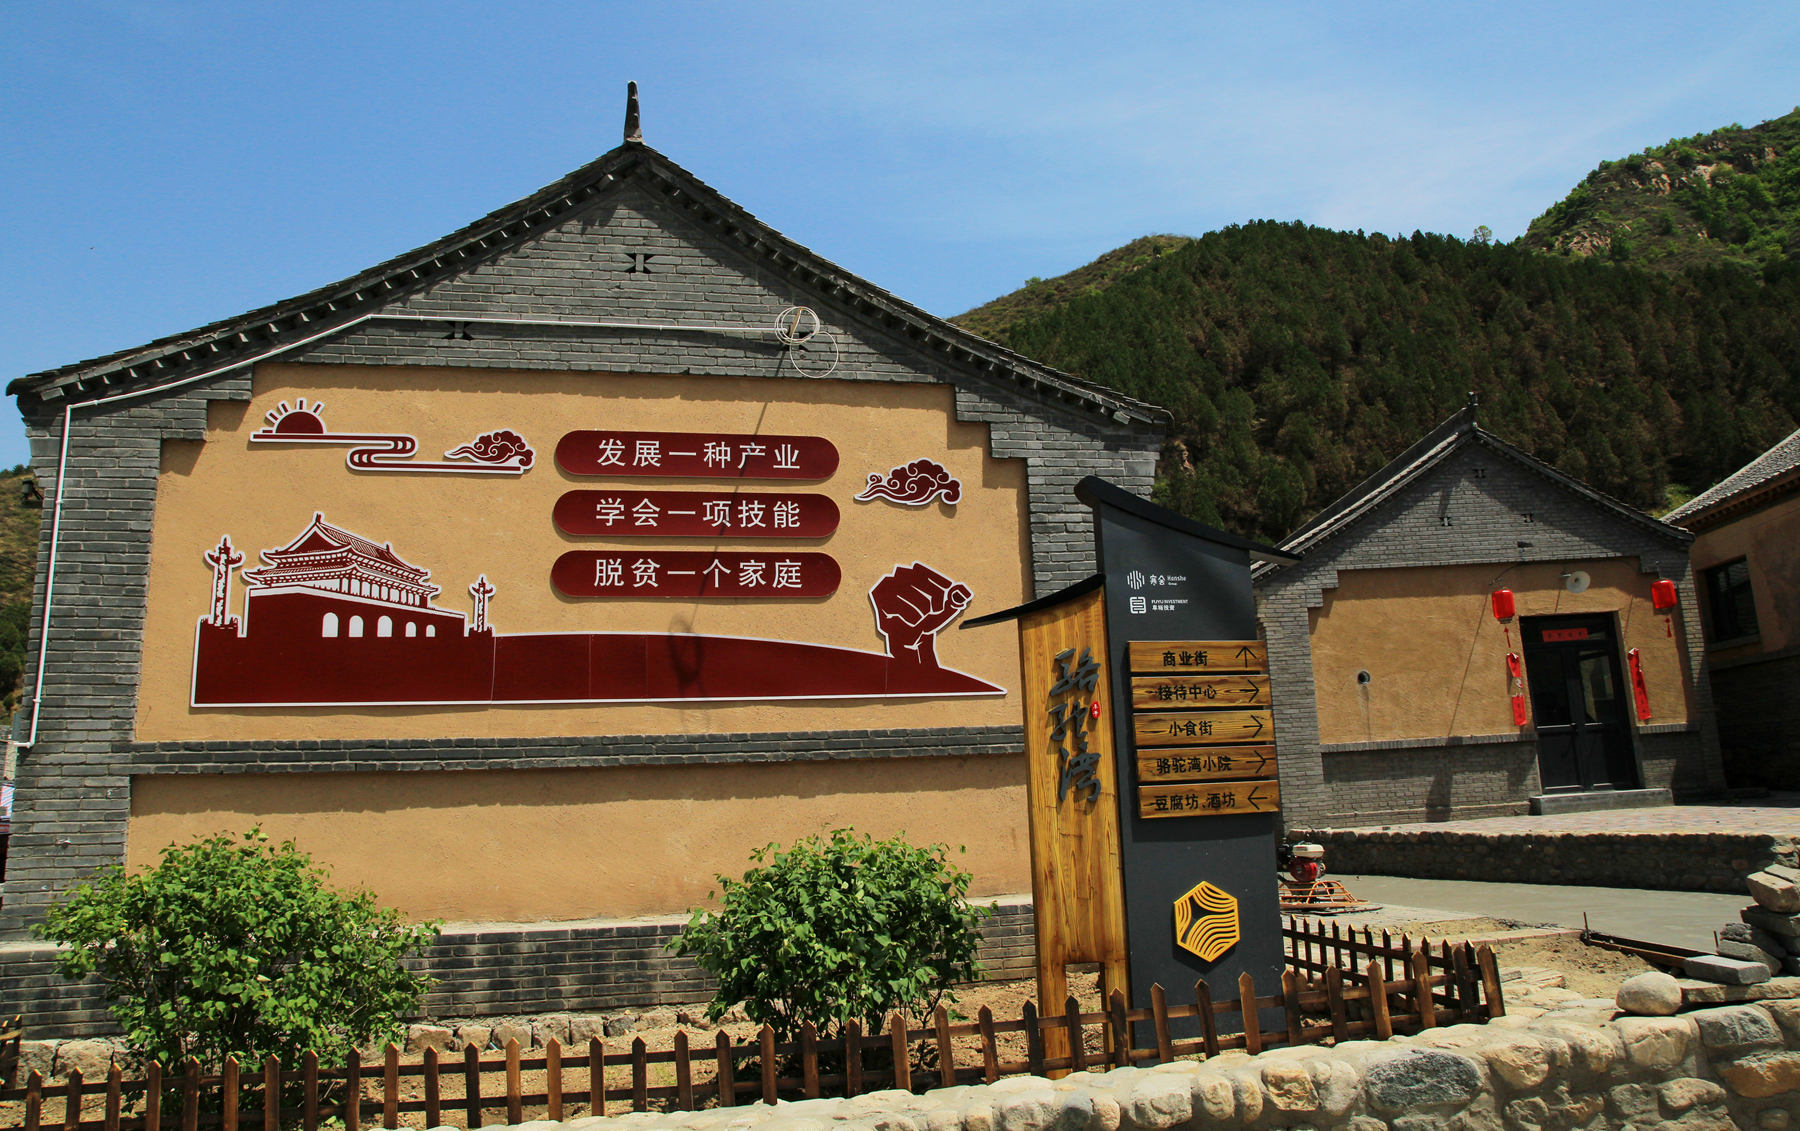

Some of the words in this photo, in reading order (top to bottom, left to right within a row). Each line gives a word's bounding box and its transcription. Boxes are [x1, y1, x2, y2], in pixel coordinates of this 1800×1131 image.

[596, 438, 801, 470] 发展一种产业
[595, 497, 801, 529] 学会一项技能
[594, 558, 803, 589] 脱贫一个家庭
[1162, 650, 1208, 667] 商业街
[1157, 685, 1217, 701] 接待中心
[1048, 647, 1102, 802] 骆驼湾
[1168, 720, 1212, 737] 小食街
[1156, 756, 1232, 774] 骆驼湾小院
[1154, 792, 1236, 812] 豆腐坊、酒坊
